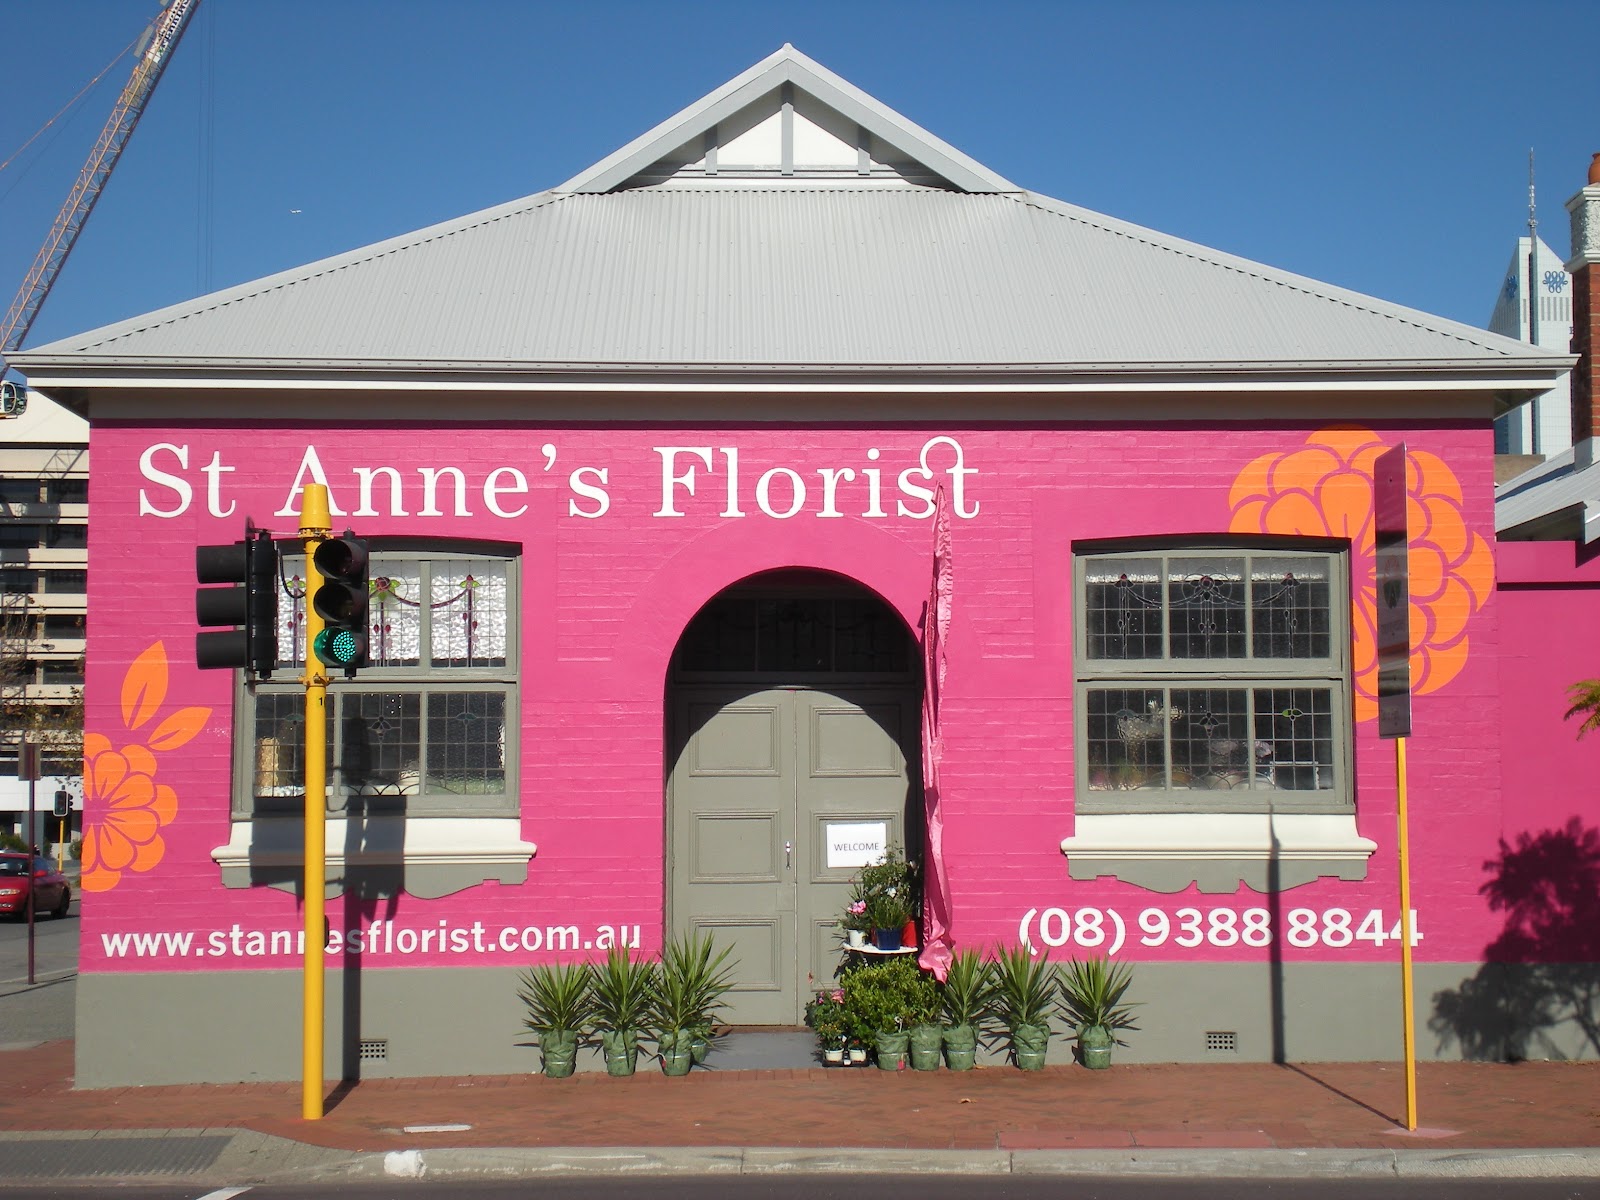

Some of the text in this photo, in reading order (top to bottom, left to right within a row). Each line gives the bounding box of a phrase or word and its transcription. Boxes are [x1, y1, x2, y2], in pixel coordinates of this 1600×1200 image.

[138, 442, 236, 518] St
[652, 435, 981, 519] Florist
[833, 842, 880, 852] WELCOME
[1018, 907, 1425, 956] (08) 9388 8844
